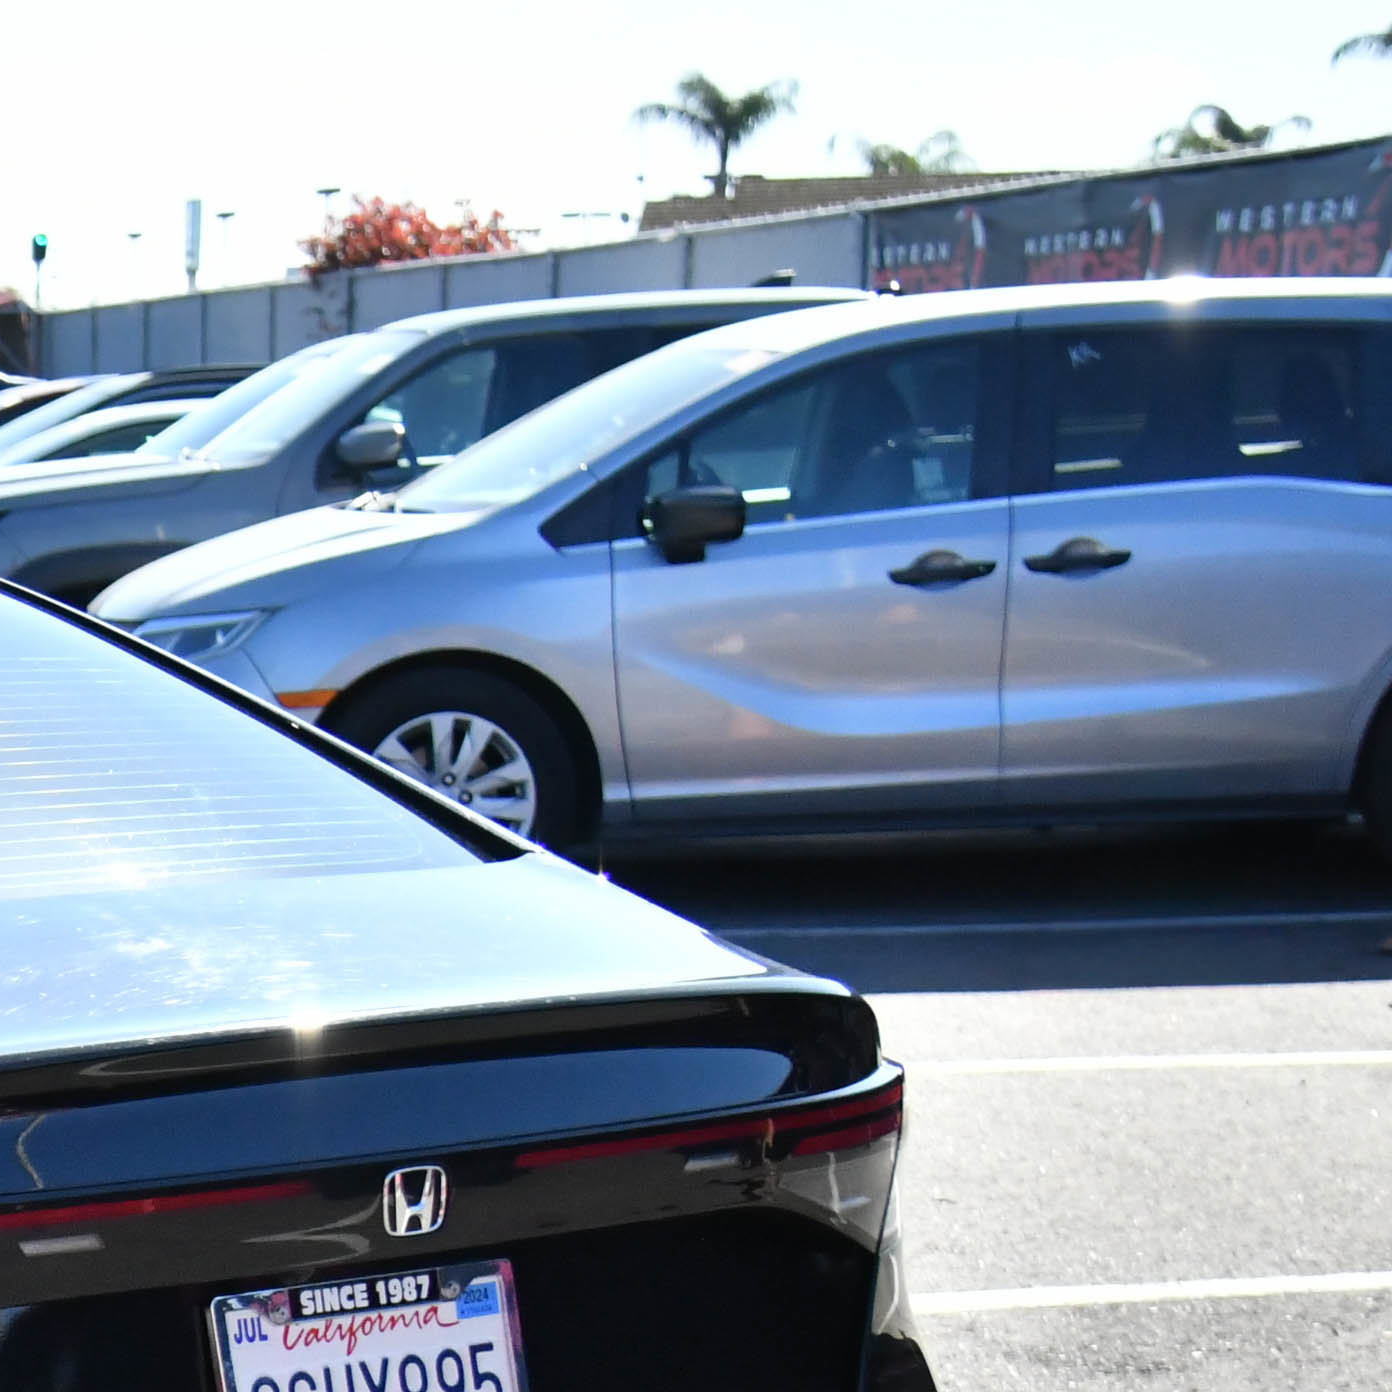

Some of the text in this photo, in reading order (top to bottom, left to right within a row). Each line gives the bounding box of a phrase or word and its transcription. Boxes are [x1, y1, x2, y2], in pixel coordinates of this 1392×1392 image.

[1216, 195, 1359, 233] WESTERN
[1217, 221, 1380, 276] MOTORS
[299, 1275, 431, 1316] SINCE 1987
[234, 1317, 269, 1345] JUL
[281, 1304, 460, 1356] California
